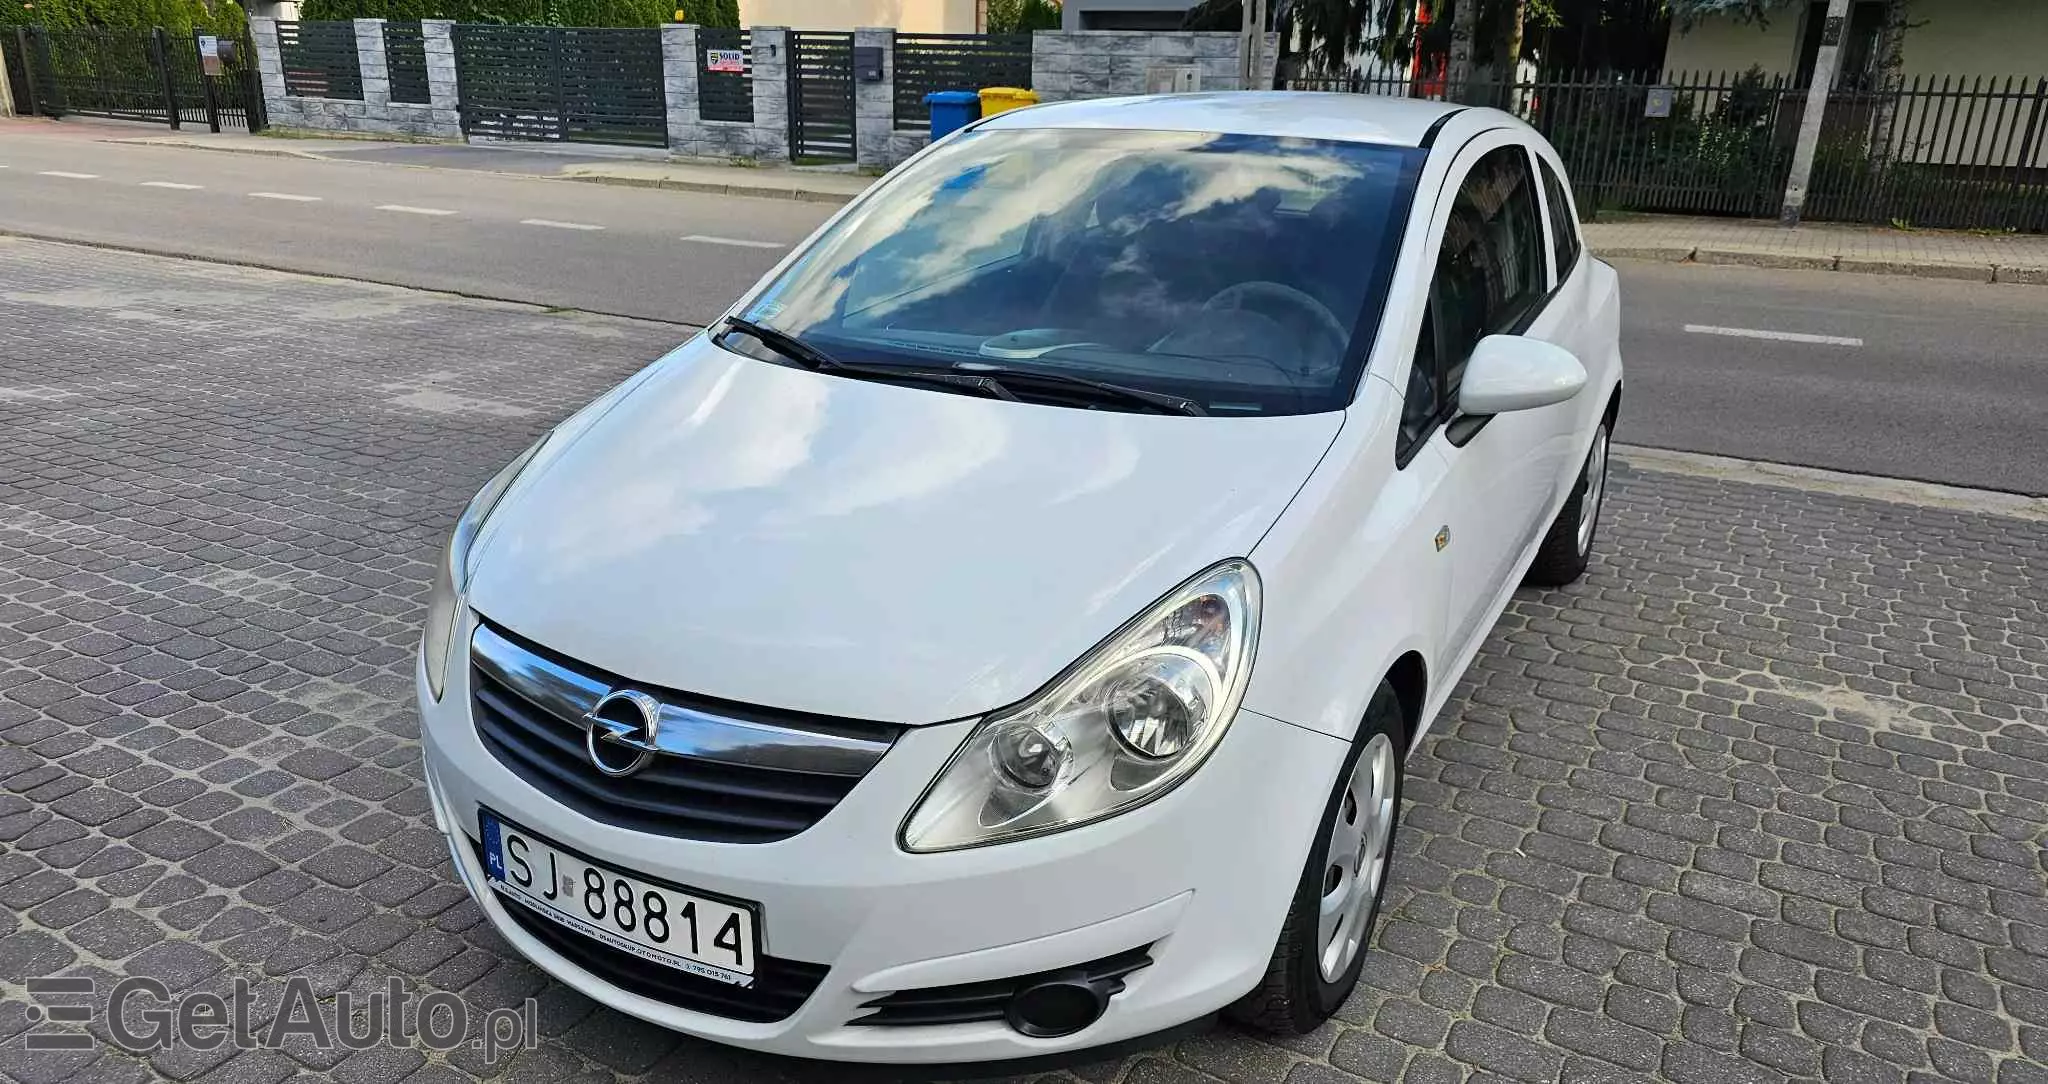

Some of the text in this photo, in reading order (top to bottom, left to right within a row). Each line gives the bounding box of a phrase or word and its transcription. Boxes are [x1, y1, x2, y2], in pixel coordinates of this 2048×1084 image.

[719, 52, 740, 60] SOLID
[489, 852, 503, 869] PL
[507, 834, 743, 966] SJ 88814
